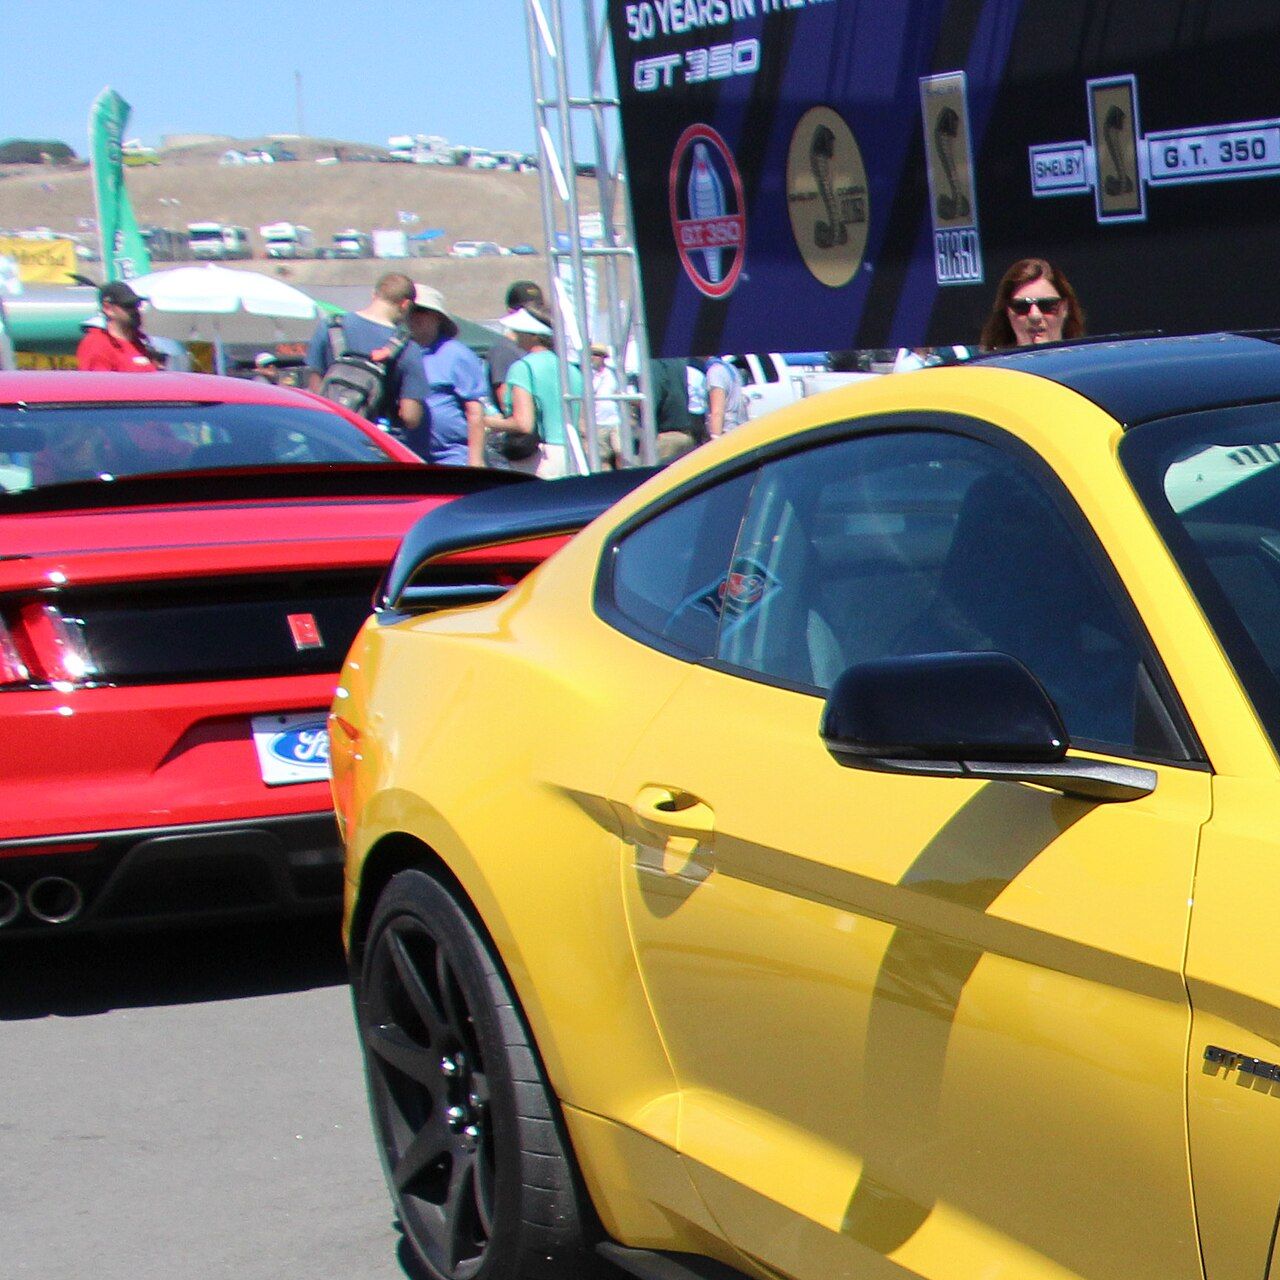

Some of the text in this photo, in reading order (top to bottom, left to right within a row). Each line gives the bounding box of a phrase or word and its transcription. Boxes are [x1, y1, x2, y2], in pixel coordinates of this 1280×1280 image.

[626, 2, 656, 41] 50
[655, 0, 730, 35] YEARS
[634, 38, 760, 91] GT 350
[1035, 157, 1082, 179] SHELBY
[1163, 138, 1266, 168] G.T. 350
[706, 221, 740, 242] 350
